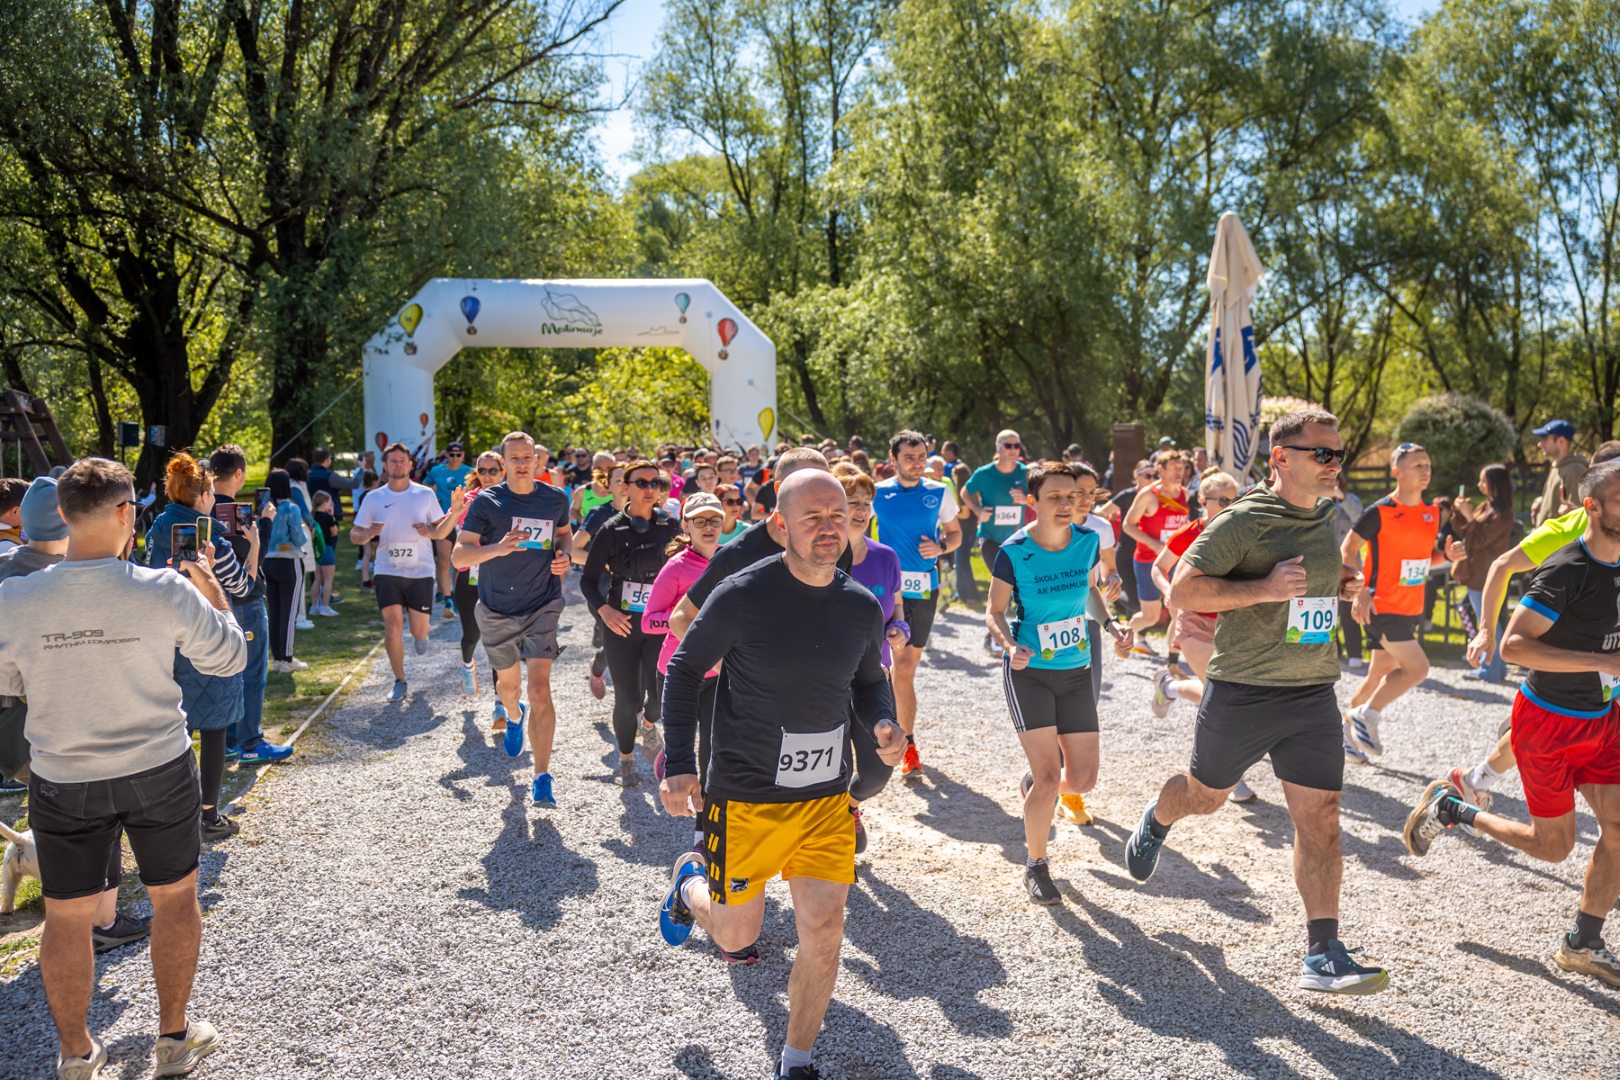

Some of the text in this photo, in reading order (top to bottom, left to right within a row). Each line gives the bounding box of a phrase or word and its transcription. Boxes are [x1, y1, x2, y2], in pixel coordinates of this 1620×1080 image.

[388, 548, 413, 558] 9372
[1408, 566, 1426, 578] 134
[904, 578, 922, 591] 98
[1037, 587, 1049, 595] AK
[632, 590, 650, 604] 56
[1300, 609, 1333, 630] 109
[41, 629, 104, 643] TR-909
[1049, 627, 1080, 649] 108
[43, 640, 86, 651] RHYTHM
[779, 746, 834, 772] 9371
